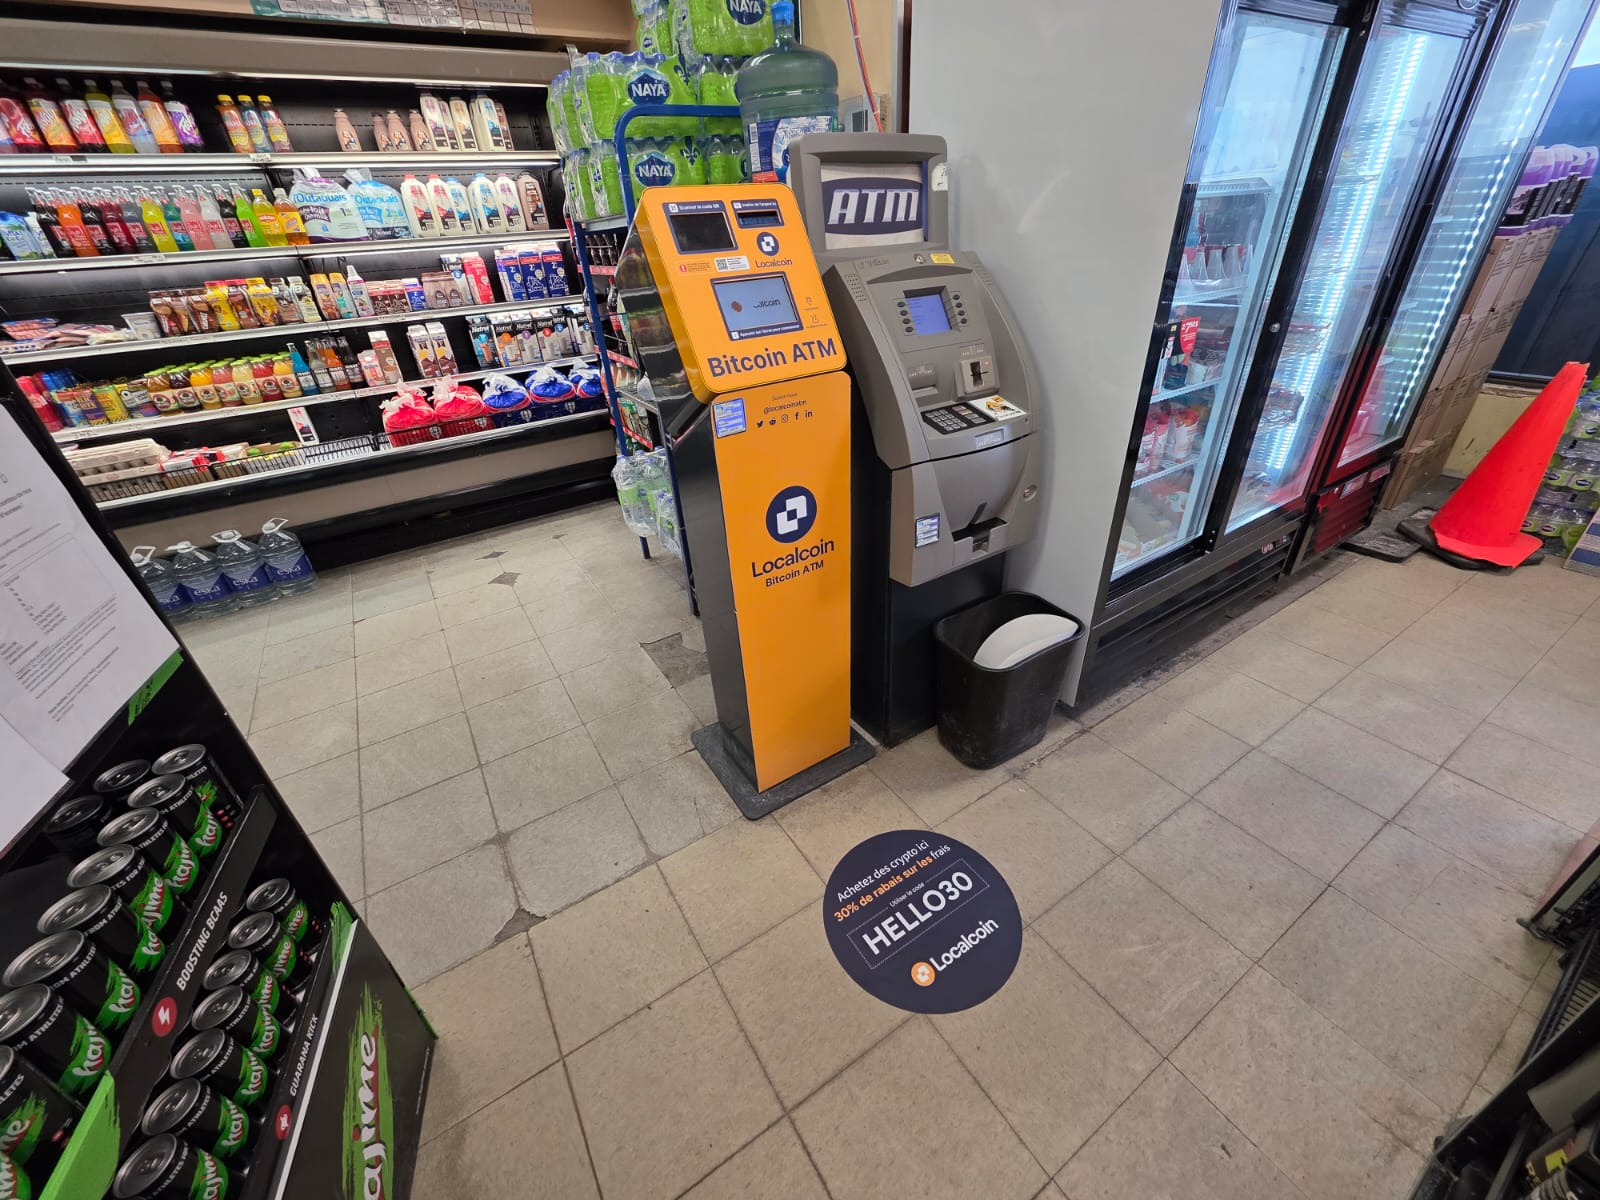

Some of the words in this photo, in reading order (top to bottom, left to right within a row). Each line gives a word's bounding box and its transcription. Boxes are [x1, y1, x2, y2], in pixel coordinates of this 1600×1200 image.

[730, 0, 762, 14] NAYA
[631, 82, 667, 97] NAYA
[638, 164, 672, 177] NAYA
[827, 188, 920, 225] ATM
[755, 259, 793, 269] Localcoin
[707, 348, 787, 378] Bitcoin
[792, 338, 838, 363] ATM
[276, 566, 302, 576] eska
[752, 539, 835, 578] Localcoin
[765, 569, 801, 588] Bitcoin
[802, 560, 825, 575] ATM
[160, 594, 179, 605] ska
[193, 585, 220, 596] eska
[232, 575, 258, 586] eska
[833, 904, 860, 923] 30%
[859, 894, 874, 907] de
[873, 874, 903, 898] rabais
[902, 865, 919, 879] sur
[917, 856, 933, 869] les
[932, 843, 951, 859] frais
[837, 875, 875, 902] Achetez
[873, 864, 891, 880] des
[889, 848, 919, 869] crypto
[917, 840, 930, 852] ici
[142, 875, 164, 929] ajime
[862, 871, 973, 956] HELLO30
[176, 928, 211, 991] BOOSTING
[205, 891, 229, 929] BCAAS
[929, 919, 1000, 972] Localcoin
[28, 1004, 62, 1043] ATHLETES
[289, 1039, 313, 1097] GUARANA
[306, 1013, 319, 1042] KICK
[0, 1074, 24, 1104] LETES
[352, 1032, 388, 1200] ajime
